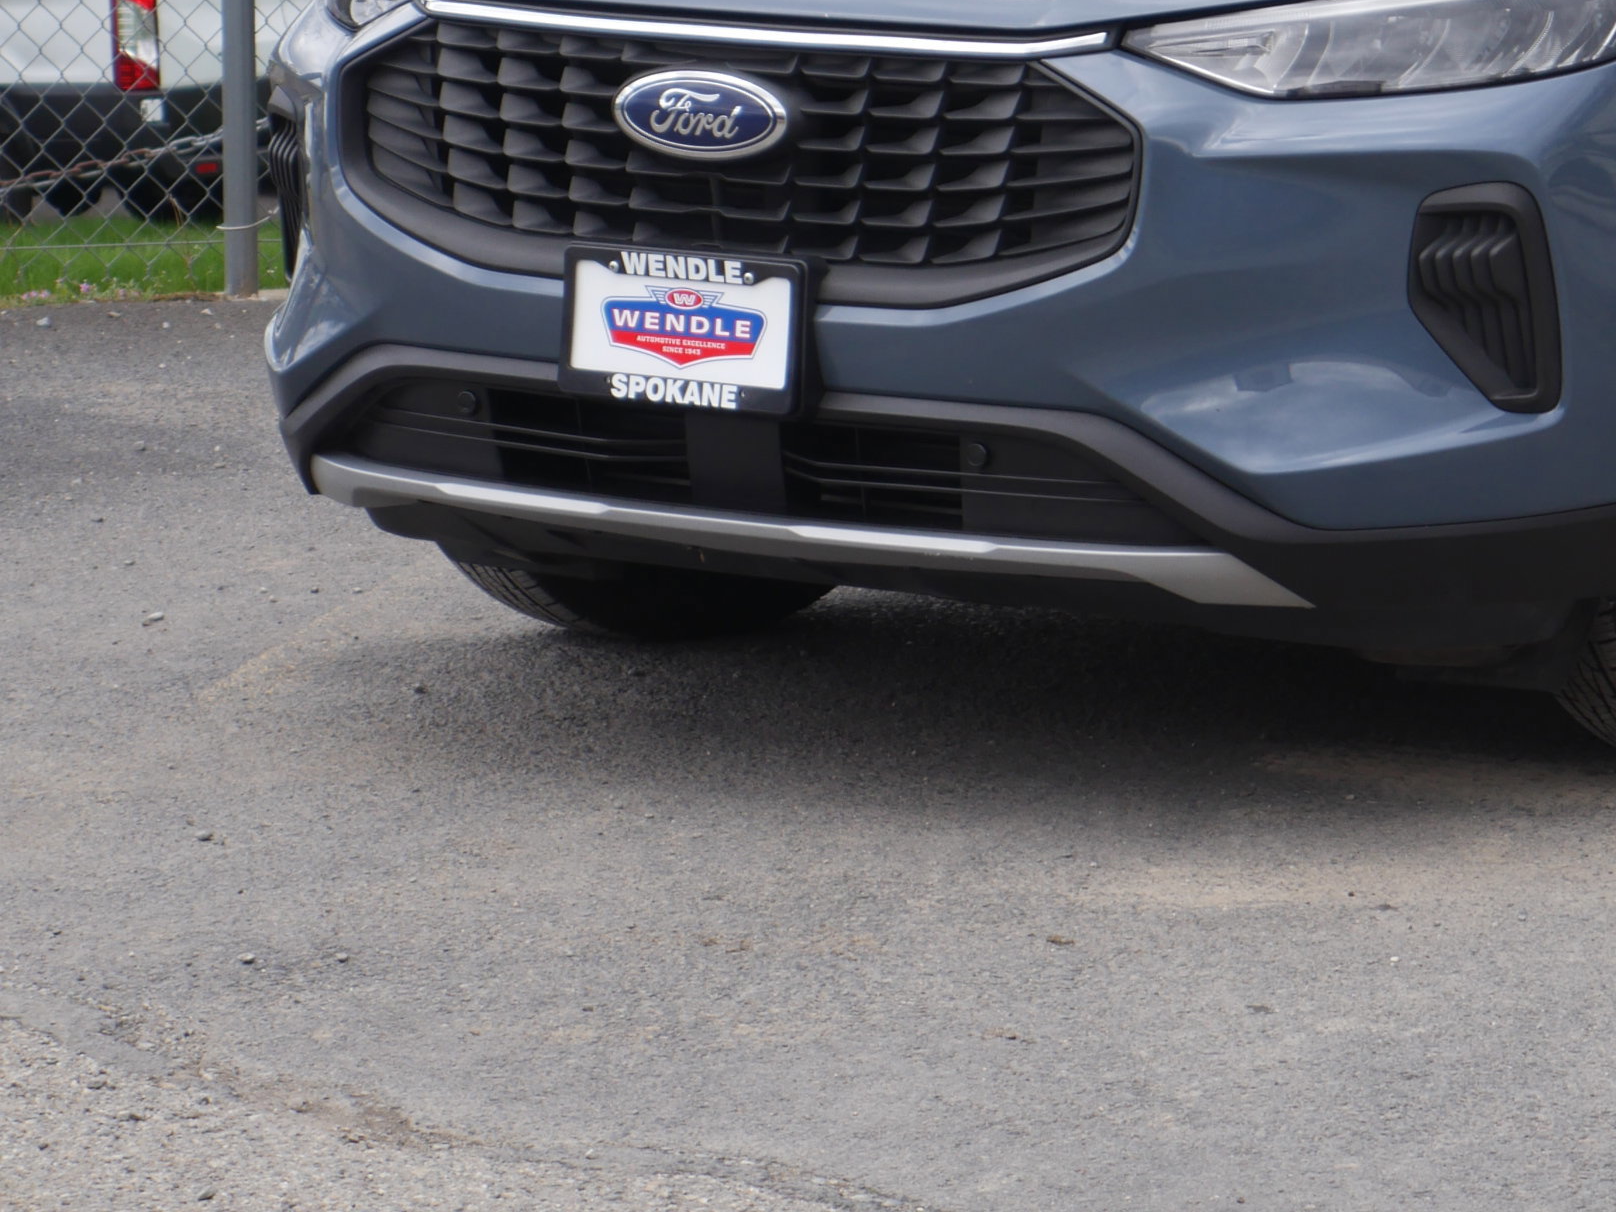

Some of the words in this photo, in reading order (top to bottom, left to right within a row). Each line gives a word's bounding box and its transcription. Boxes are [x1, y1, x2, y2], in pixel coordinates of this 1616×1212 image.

[650, 88, 743, 139] Ford
[620, 251, 744, 284] WENDLE
[673, 292, 696, 306] W
[612, 308, 752, 338] WENDLE
[636, 335, 681, 345] AUTOMOTIVE
[682, 339, 726, 349] EXCELLENCE
[662, 345, 683, 354] SINCE
[610, 373, 738, 409] SPOKANE
